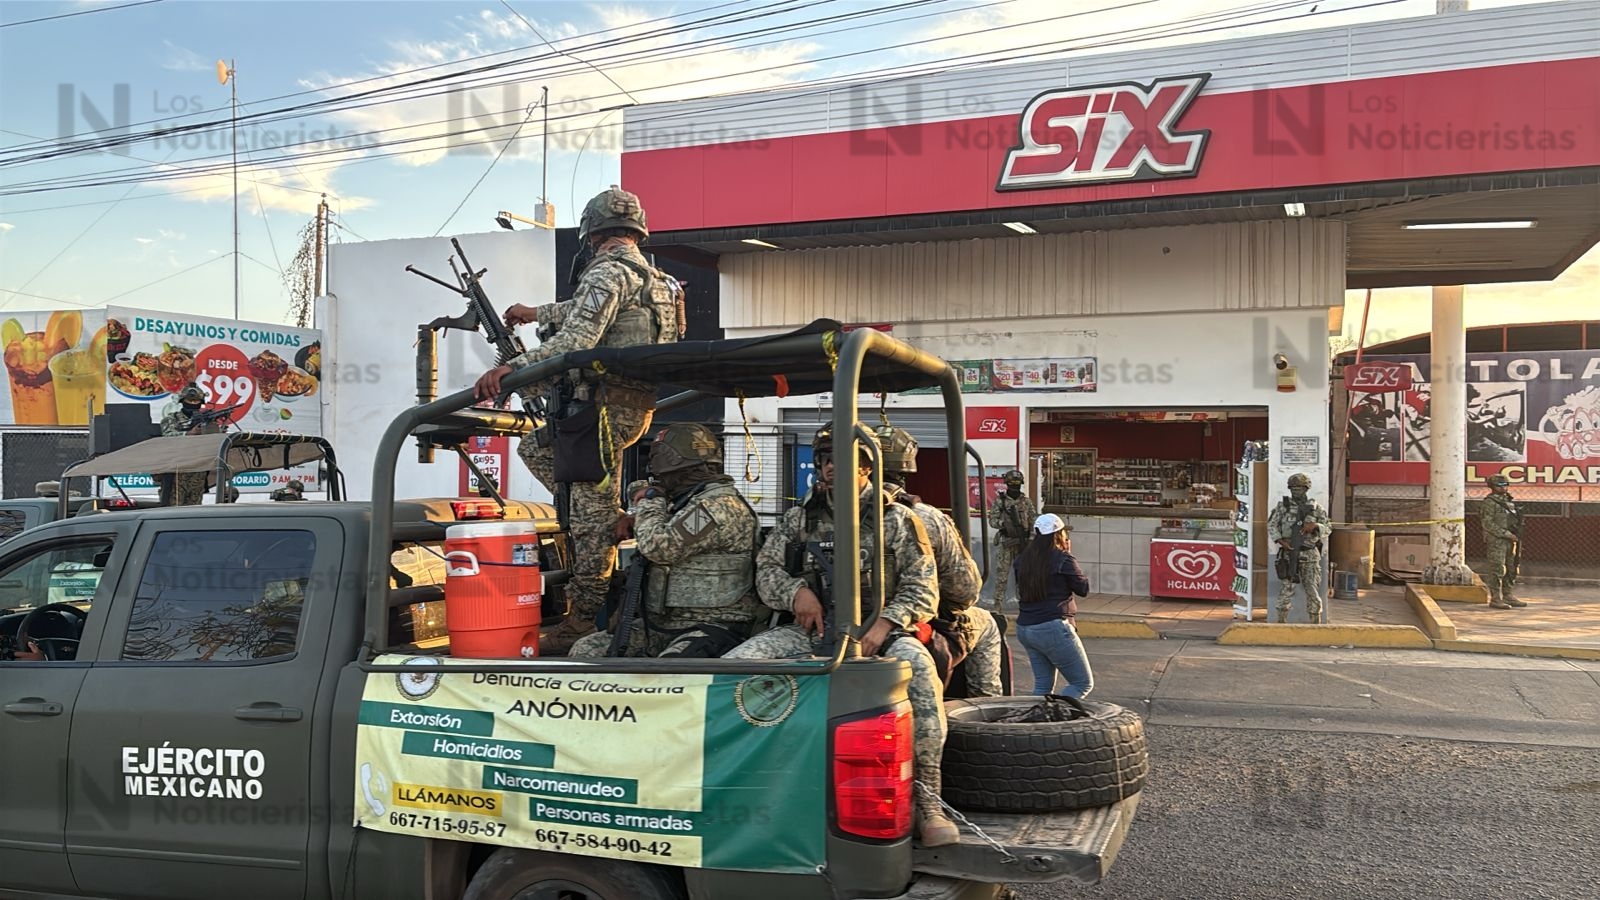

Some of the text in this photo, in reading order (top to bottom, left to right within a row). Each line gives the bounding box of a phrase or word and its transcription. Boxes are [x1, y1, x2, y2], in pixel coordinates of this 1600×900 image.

[135, 317, 300, 347] DESAYUNOS Y COMIDAS
[208, 359, 238, 370] DESDE
[195, 369, 253, 405] $99
[113, 475, 154, 486] TELÉFON
[272, 475, 277, 483] 9
[304, 475, 315, 483] PM
[473, 673, 562, 690] Denuncia
[390, 709, 462, 729] Extorsión
[506, 697, 637, 723] ANÓNIMA
[122, 741, 265, 778] EJÉRCITO
[433, 739, 522, 761] Homicidios
[124, 776, 263, 800] MEXICANO
[493, 772, 625, 799] Narcomenudeo
[398, 786, 496, 811] LLÁMANOS
[390, 811, 507, 838] 667-715-95-87
[536, 803, 611, 825] Personas
[615, 812, 693, 831] armadas
[536, 828, 672, 857] 667-584-90-42
